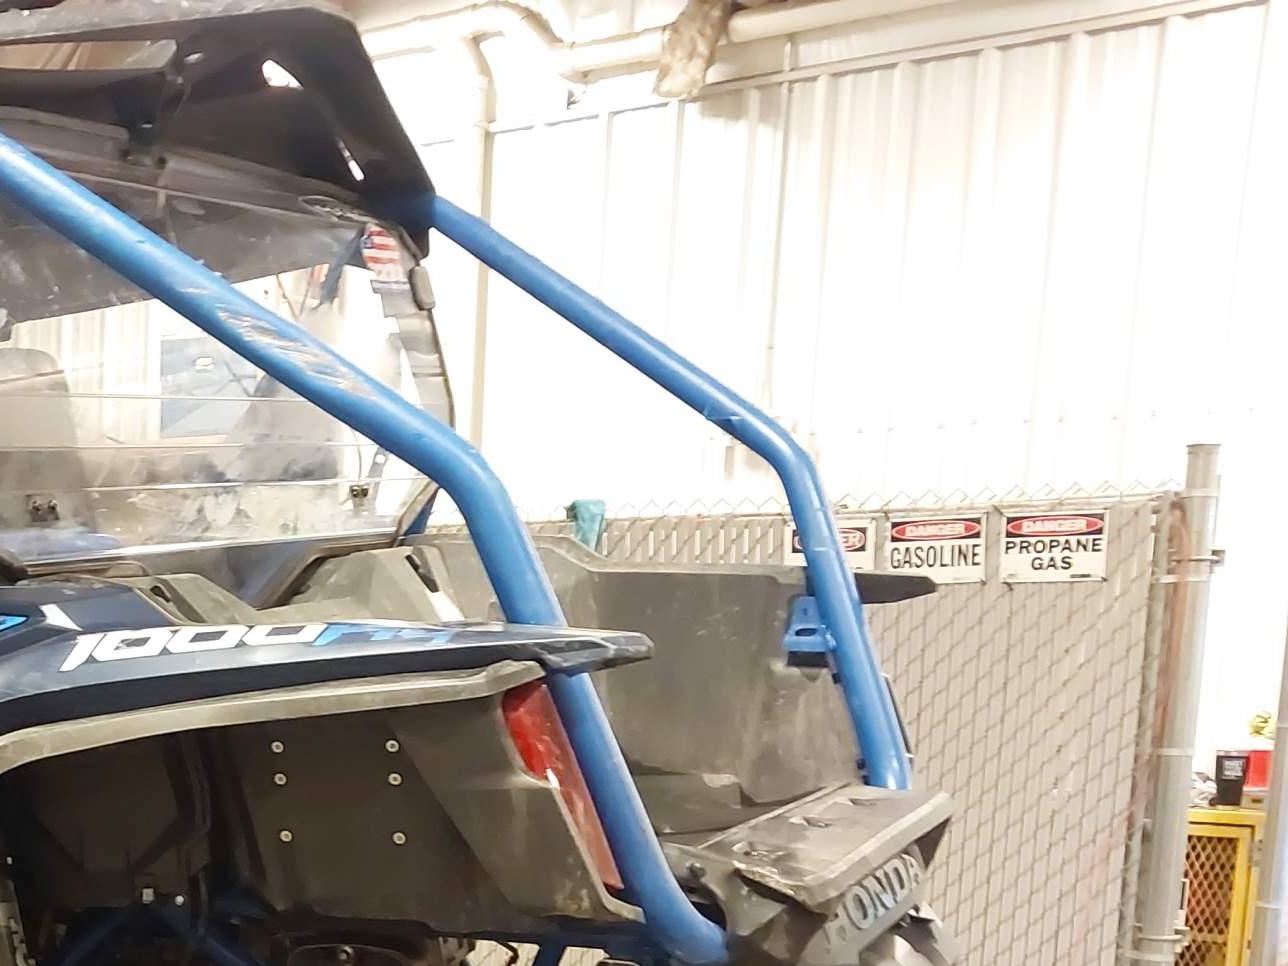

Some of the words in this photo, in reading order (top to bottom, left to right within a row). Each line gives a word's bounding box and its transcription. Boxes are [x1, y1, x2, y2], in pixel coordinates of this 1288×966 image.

[904, 522, 966, 537] DANGER
[1021, 518, 1087, 533] DANGER
[1004, 537, 1103, 554] PROPANE
[890, 543, 982, 570] GASOLINE
[1031, 555, 1073, 571] GAS
